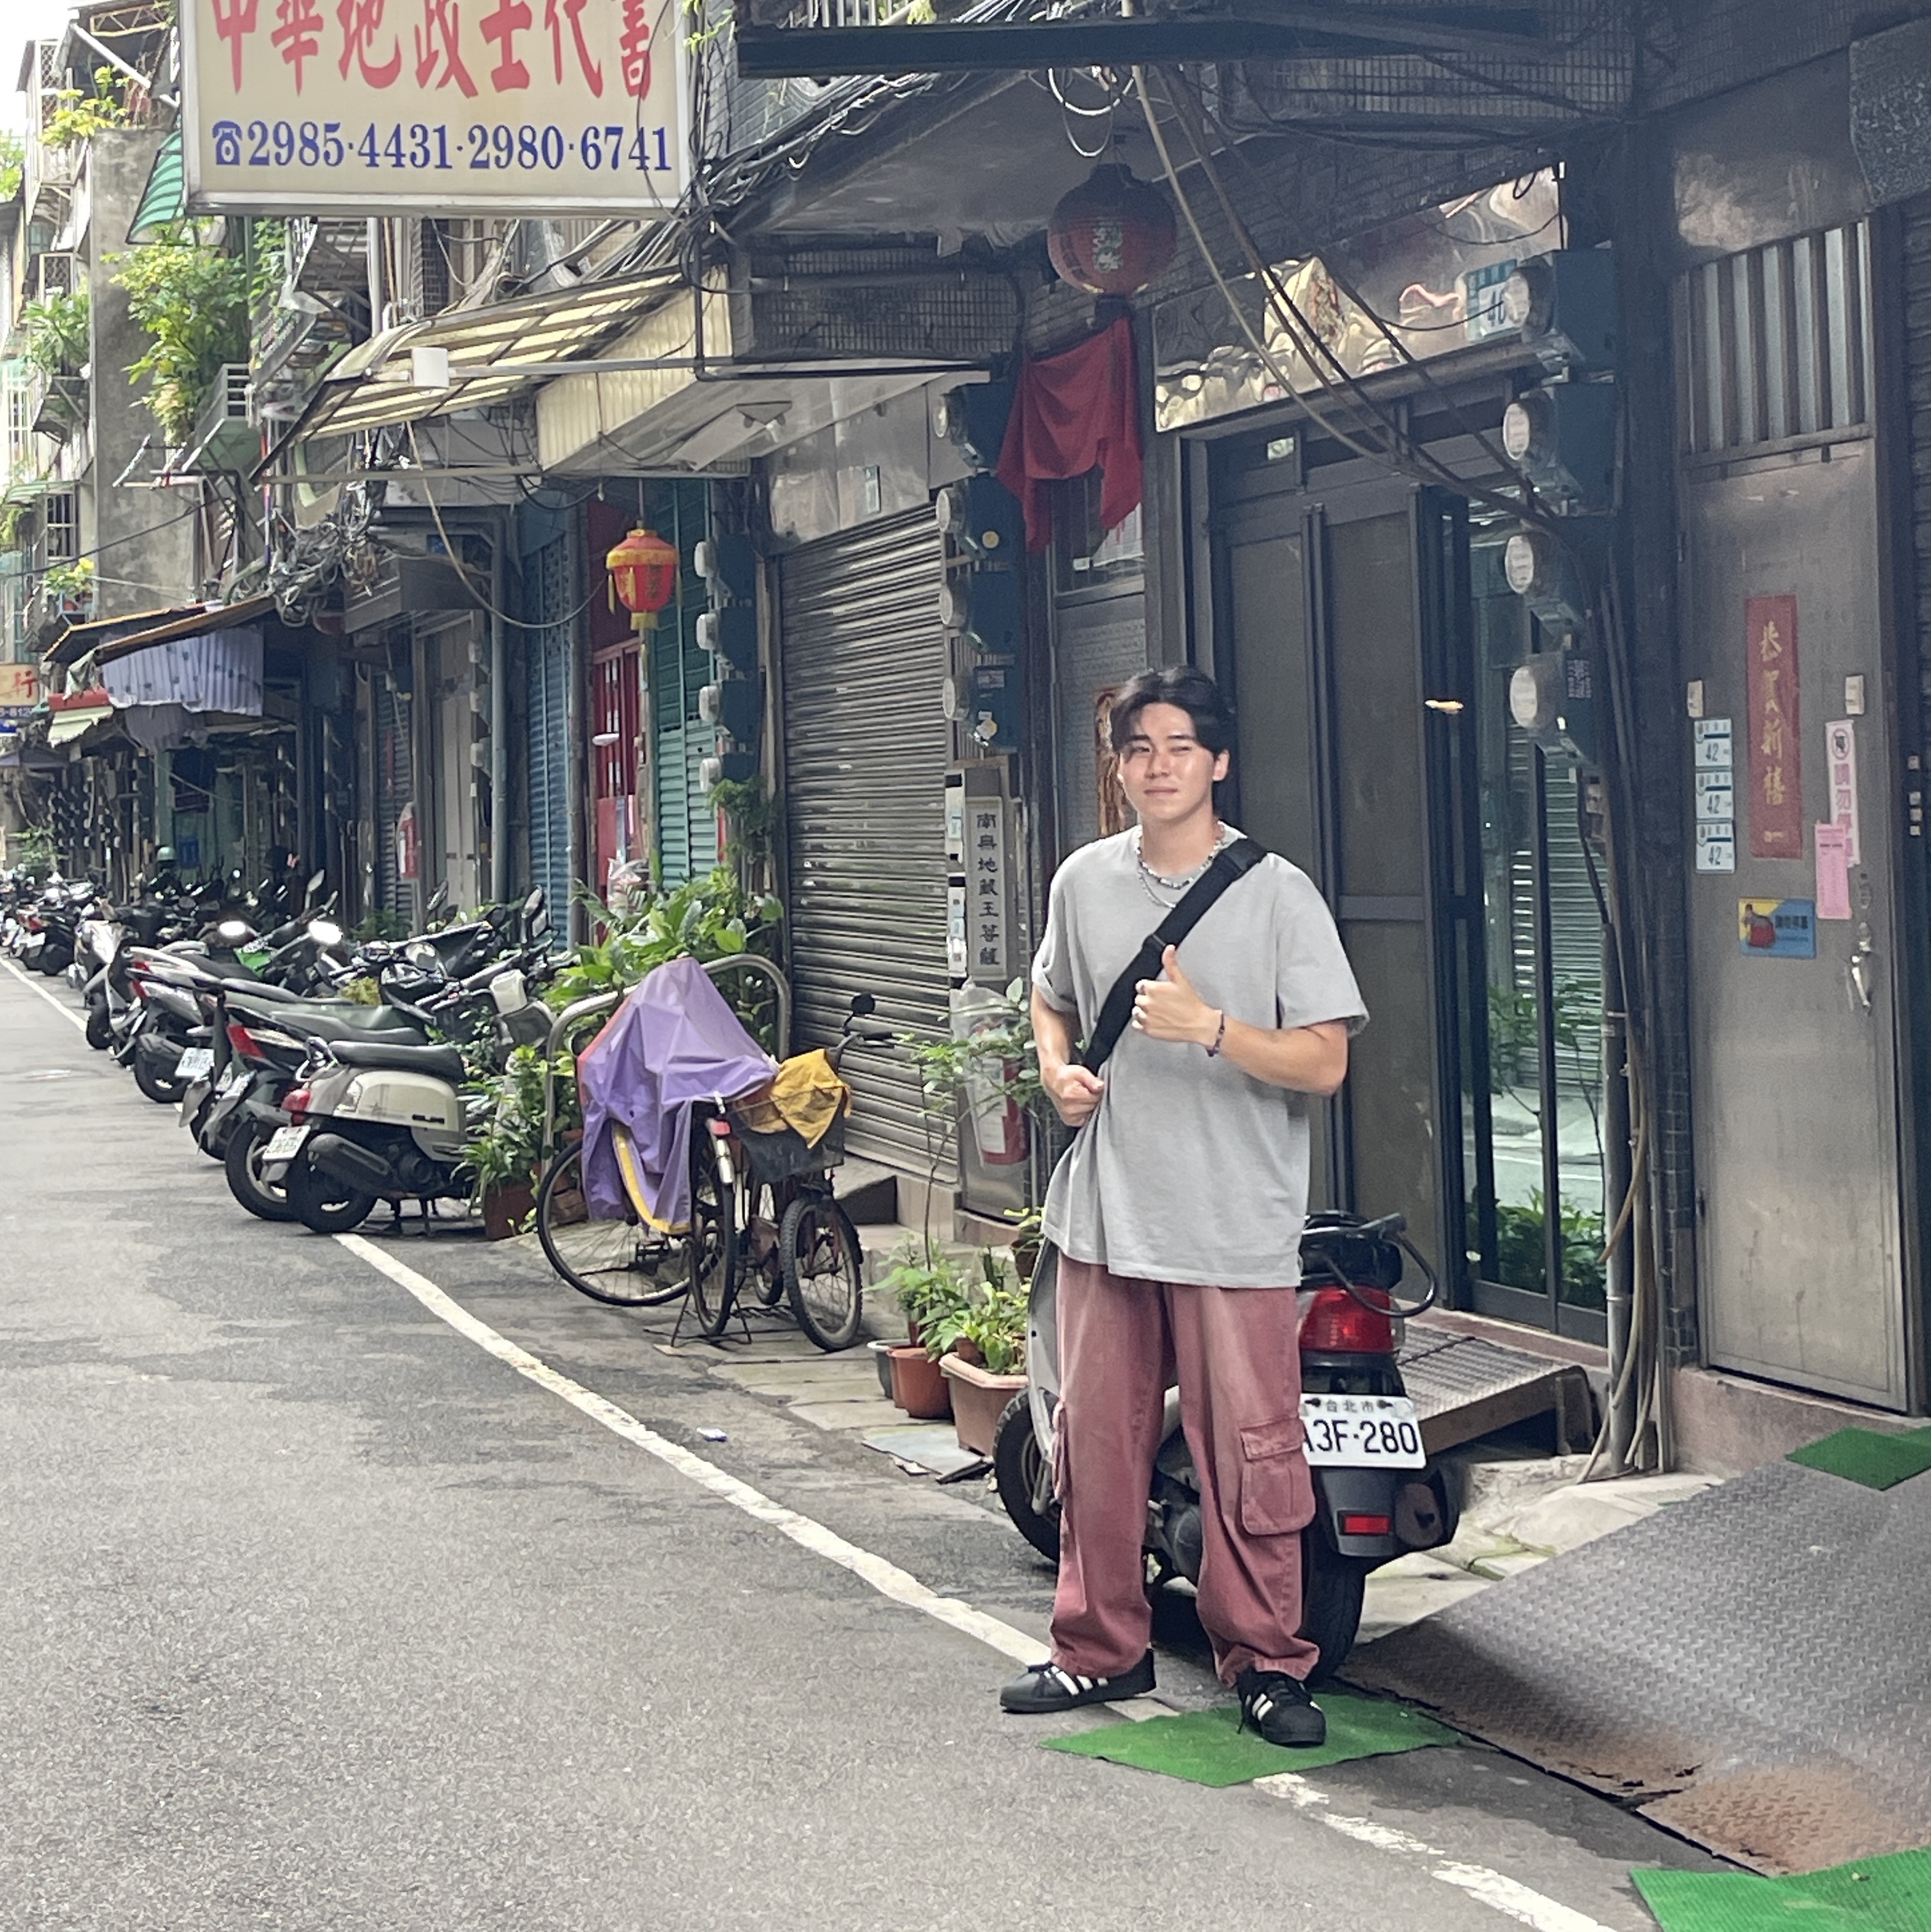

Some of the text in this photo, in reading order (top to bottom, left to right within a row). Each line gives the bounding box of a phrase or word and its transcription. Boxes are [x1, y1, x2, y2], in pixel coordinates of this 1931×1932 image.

[1706, 742, 1720, 762] 42
[1707, 794, 1720, 815] 42
[1708, 845, 1722, 866] 42
[1325, 1399, 1374, 1414] 台北市
